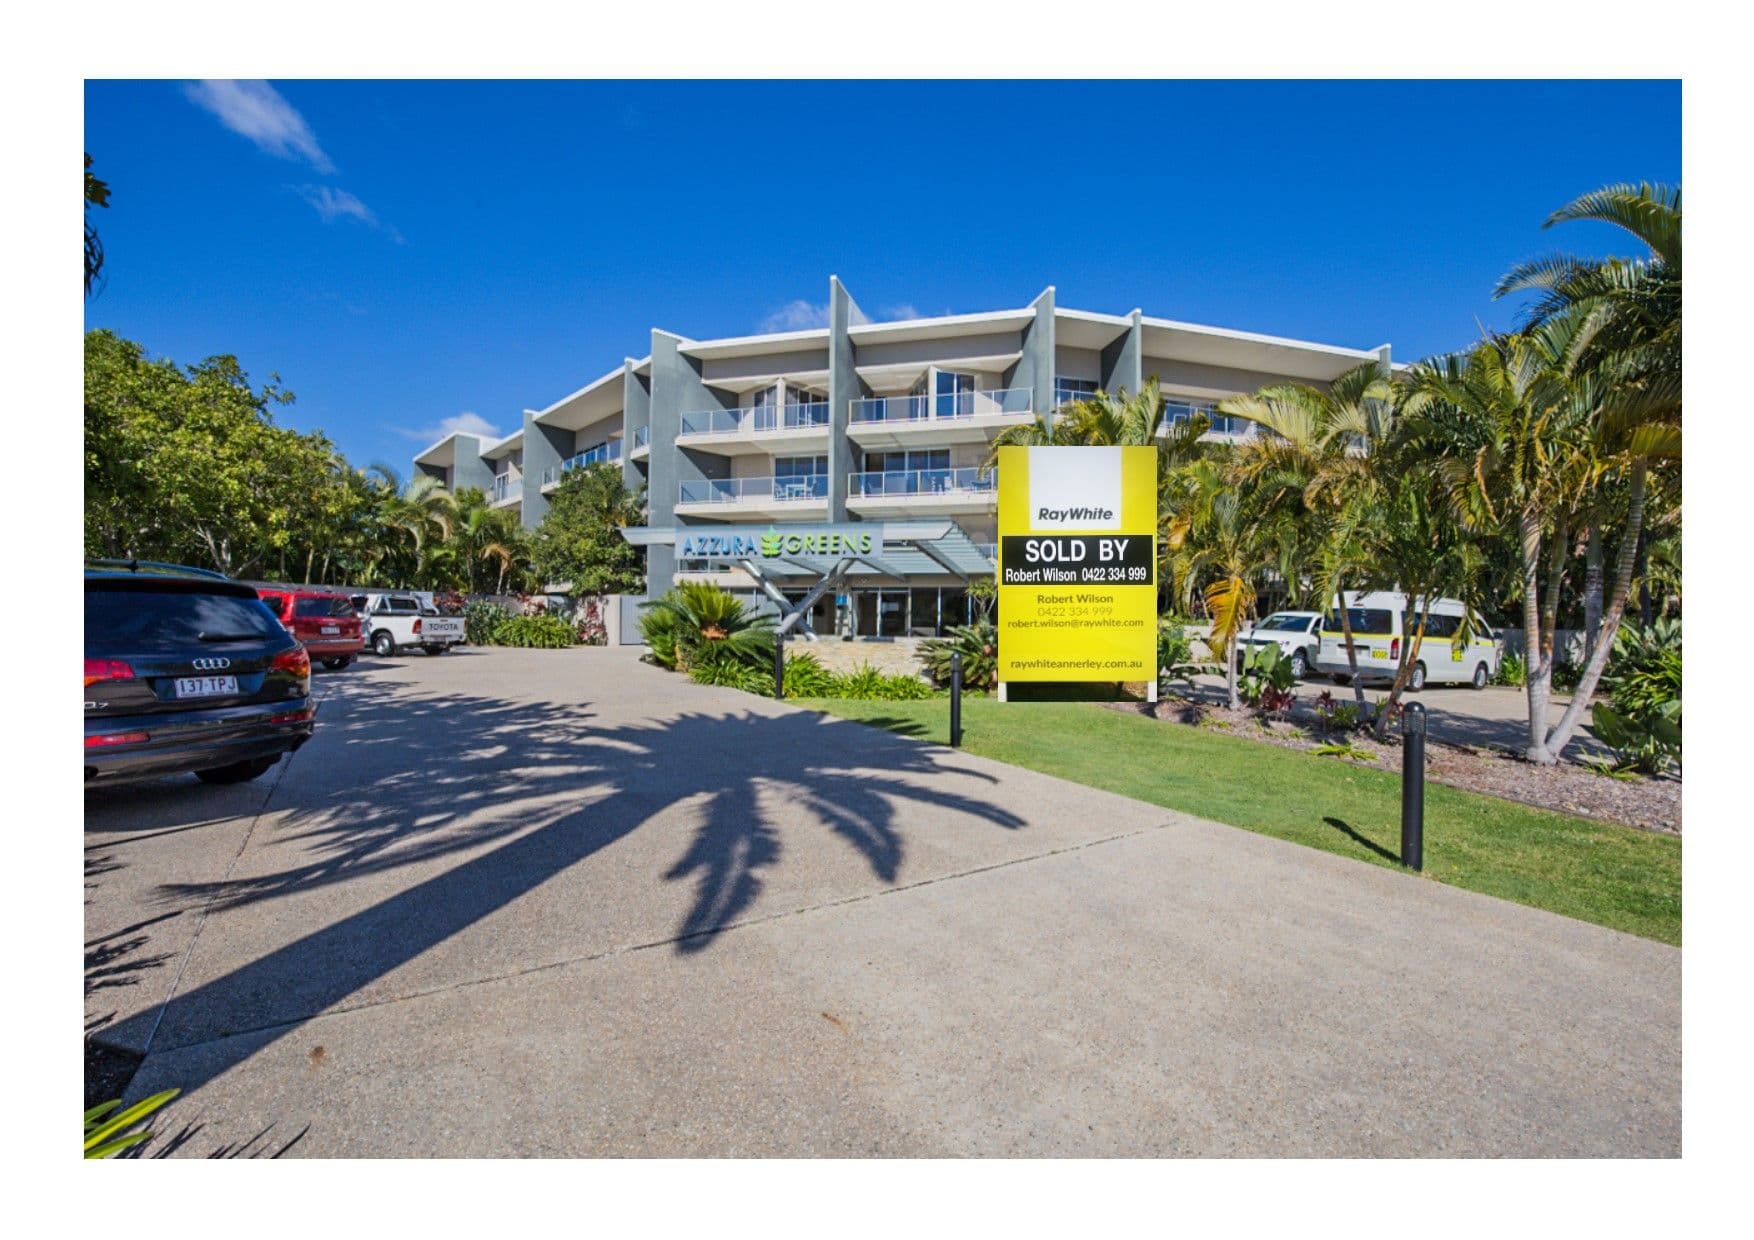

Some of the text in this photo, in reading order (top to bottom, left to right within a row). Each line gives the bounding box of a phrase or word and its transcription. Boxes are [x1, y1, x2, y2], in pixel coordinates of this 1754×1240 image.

[683, 533, 872, 556] AZZURA GREENS
[1025, 539, 1129, 562] SOLD BY
[1005, 566, 1147, 582] Robert Wilson 0422 334 999
[1037, 594, 1114, 604] Robert Wilson
[1037, 606, 1113, 617] 0422 334 999
[429, 623, 458, 631] TOYOTA
[1008, 619, 1144, 629] robert.wilson@raywhite.com
[1010, 659, 1143, 672] raywhiteannerley.com.au
[179, 679, 203, 693] 137
